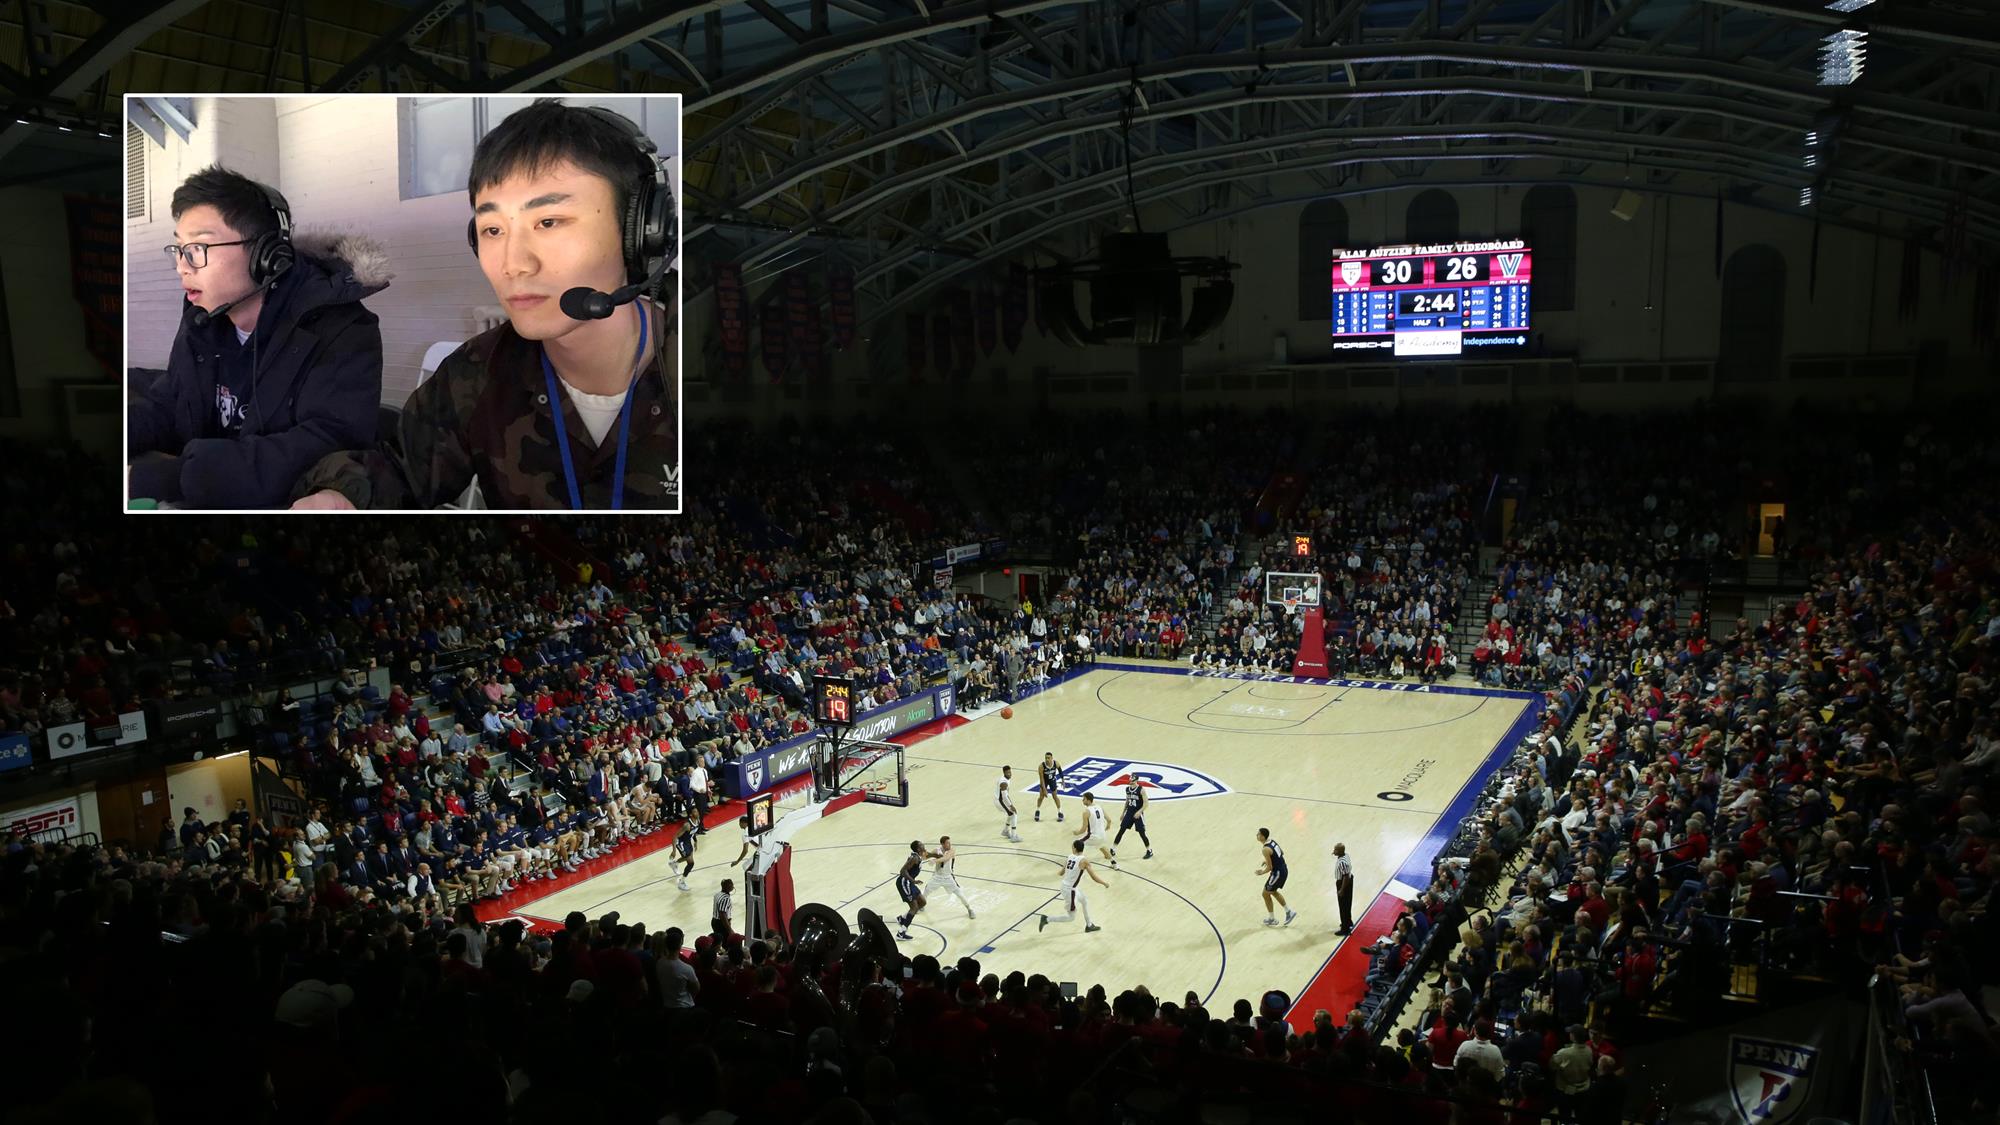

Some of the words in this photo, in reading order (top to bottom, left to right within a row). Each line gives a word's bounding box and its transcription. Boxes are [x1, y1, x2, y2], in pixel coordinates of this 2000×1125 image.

[1339, 249, 1367, 259] ALAN
[1415, 244, 1453, 254] FAMILY
[1456, 241, 1524, 252] VIDEOBOARD
[1382, 260, 1412, 283] 30
[1446, 256, 1477, 280] 26
[1414, 294, 1455, 312] 2:44
[1438, 317, 1444, 327] 1
[1333, 341, 1394, 349] PORSCHE
[1463, 336, 1516, 349] Independence
[1297, 544, 1308, 555] 19
[1187, 670, 1245, 680] THE
[1258, 674, 1430, 692] PALESTRA
[826, 685, 849, 698] 2:44
[167, 707, 217, 722] PORSCHE
[829, 700, 846, 720] 19
[779, 752, 797, 774] WE
[853, 715, 896, 741] SOLUTION
[752, 772, 759, 785] P
[12, 807, 74, 836] ESPN
[1095, 810, 1101, 819] 0
[1066, 860, 1076, 870] 23
[1736, 1042, 1811, 1071] PENN
[1751, 1071, 1792, 1119] P
